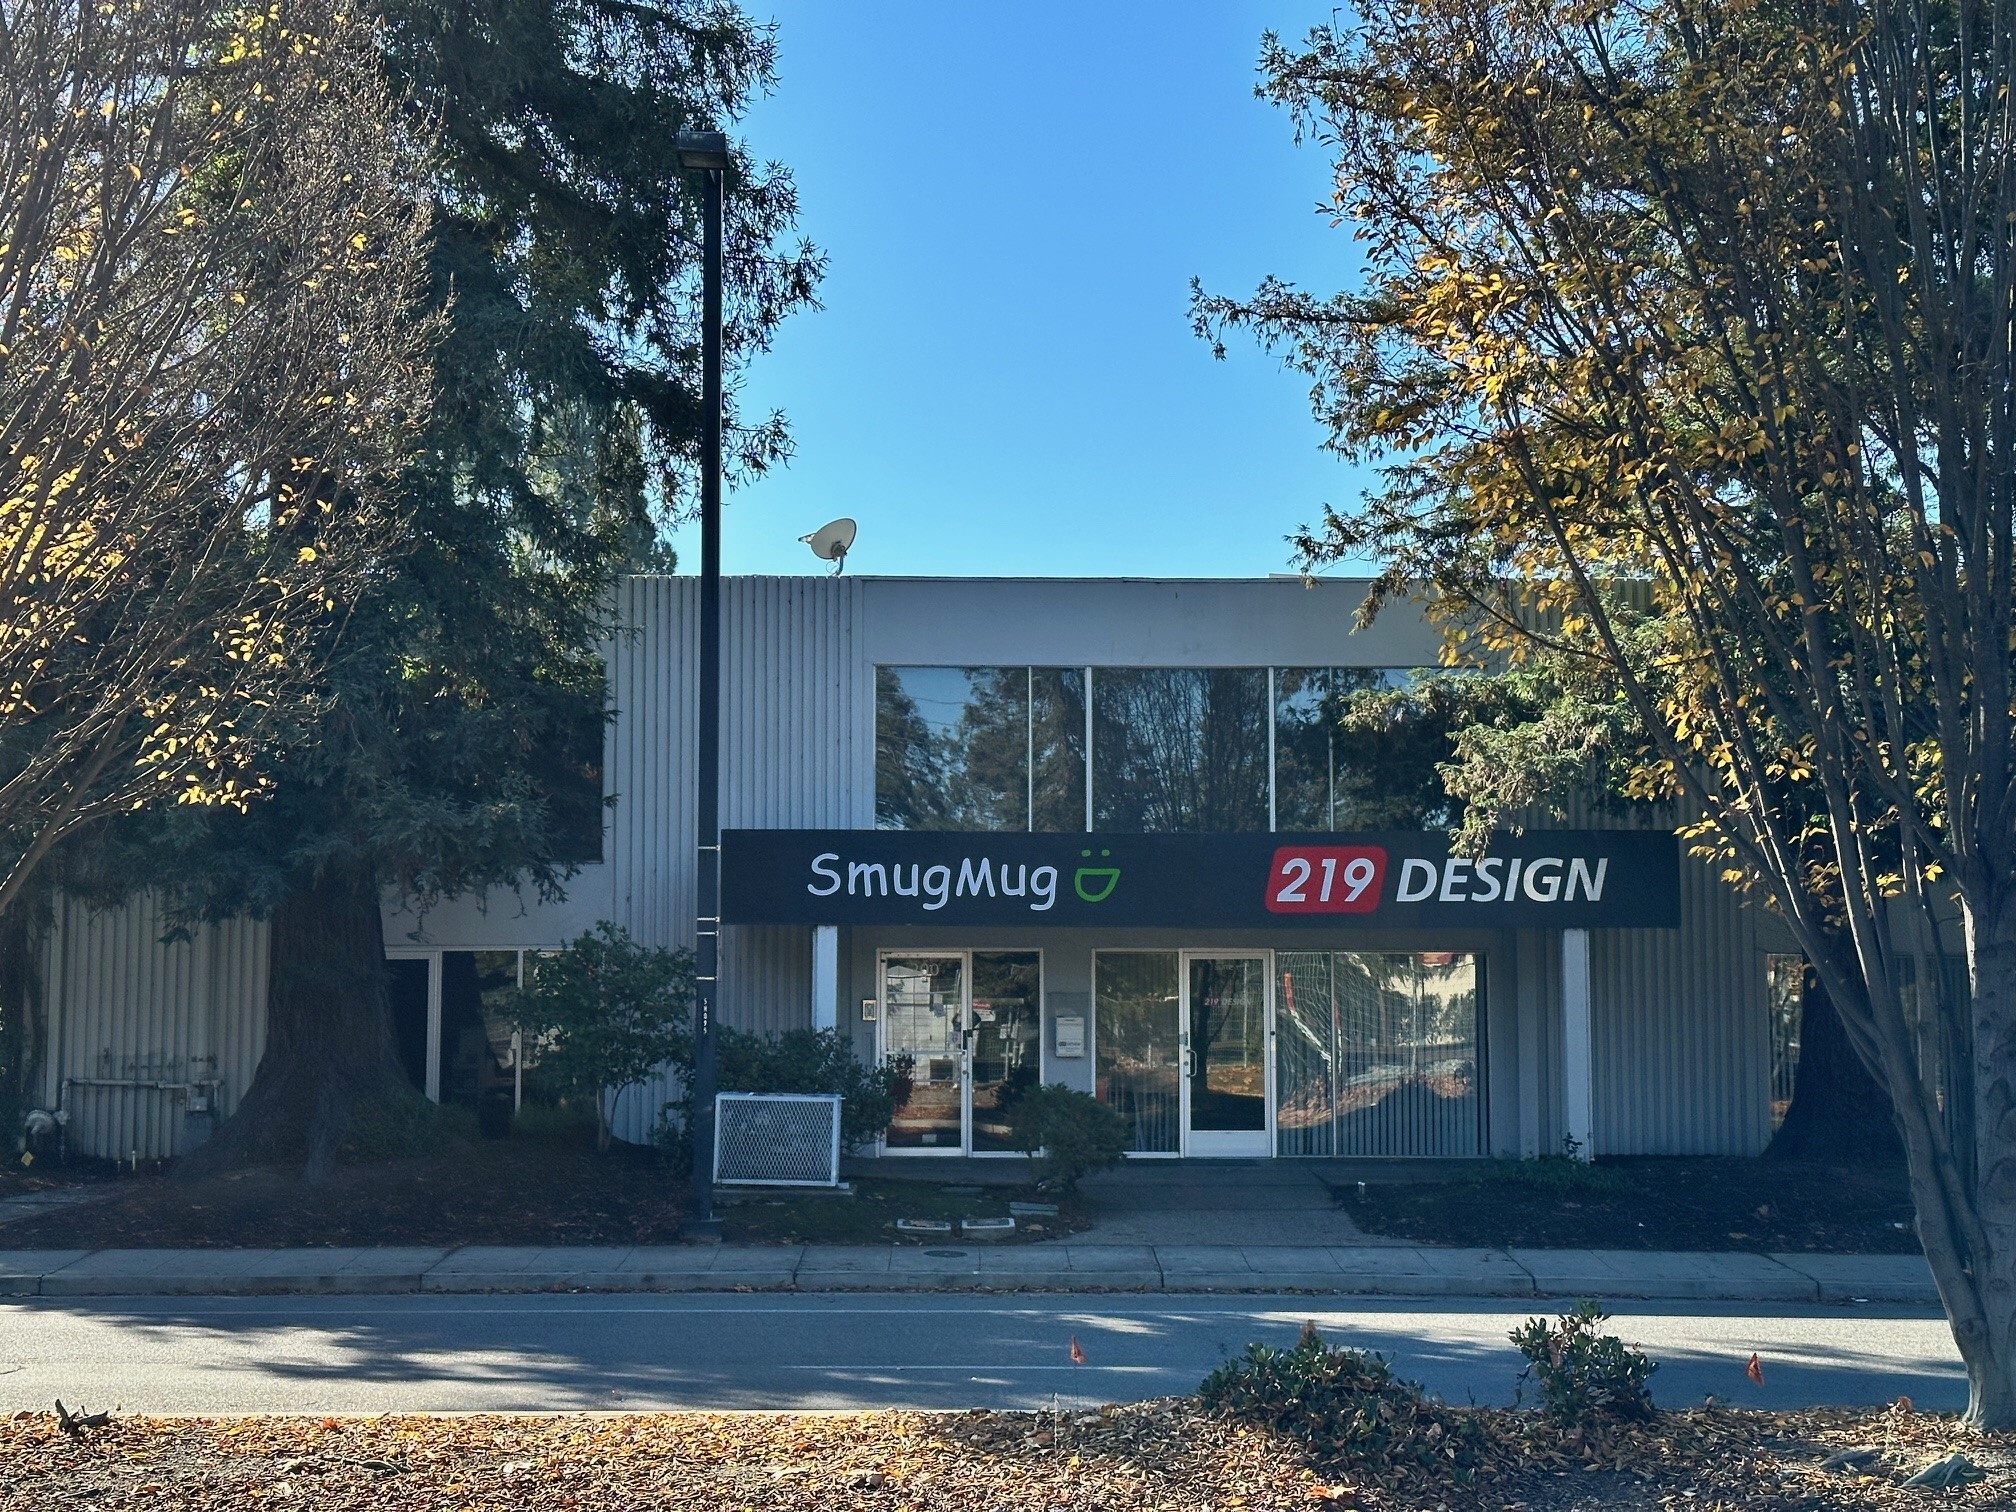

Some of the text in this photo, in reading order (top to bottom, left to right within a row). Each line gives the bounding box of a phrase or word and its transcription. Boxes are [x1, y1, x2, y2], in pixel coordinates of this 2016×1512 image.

[807, 853, 1058, 911] SmugMug
[1276, 858, 1608, 902] 219 DESIGN
[1204, 998, 1219, 1006] 219
